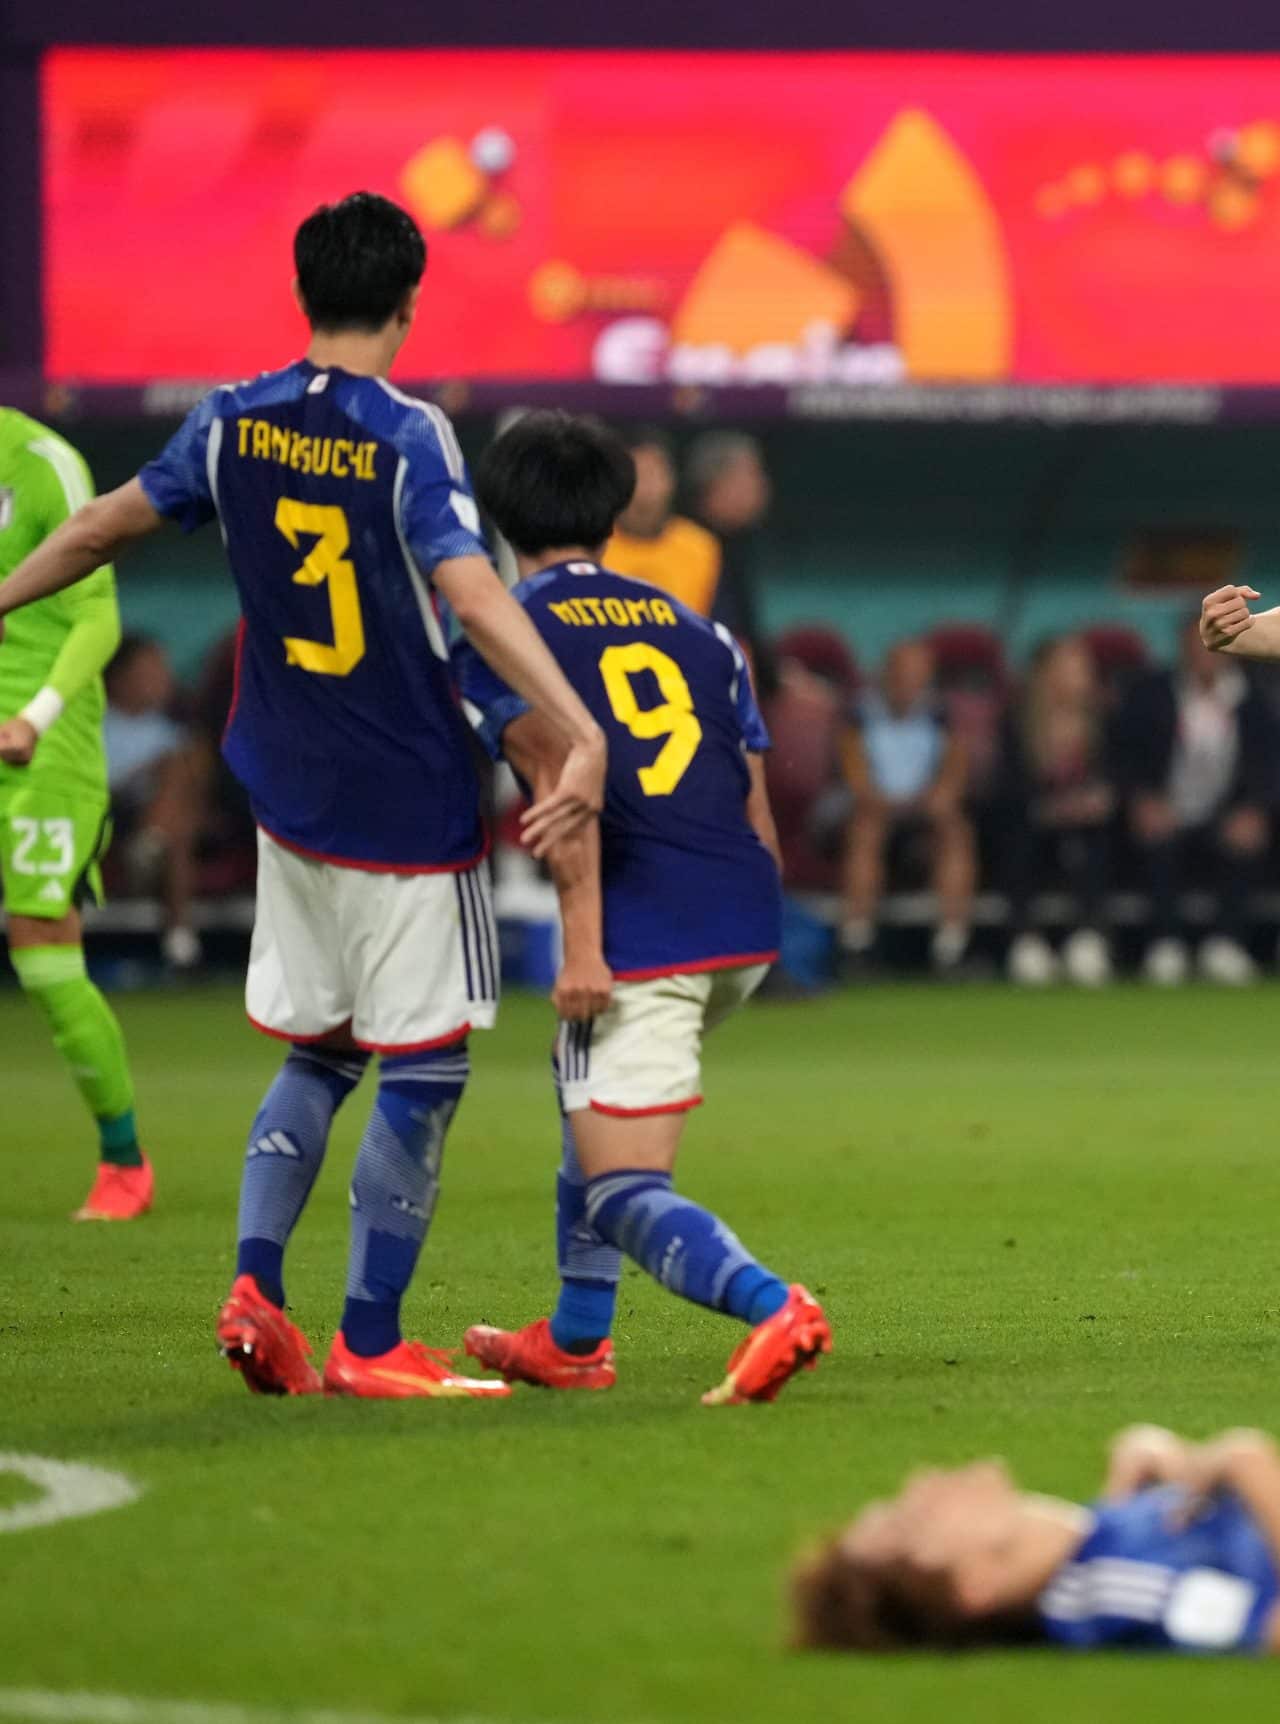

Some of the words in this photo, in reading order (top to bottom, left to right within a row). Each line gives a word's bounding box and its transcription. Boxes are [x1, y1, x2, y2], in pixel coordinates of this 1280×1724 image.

[237, 418, 378, 480] TANIGUCHI
[274, 496, 365, 676] 3
[548, 597, 678, 627] MITOMA
[599, 641, 703, 796] 9
[11, 816, 74, 876] 23
